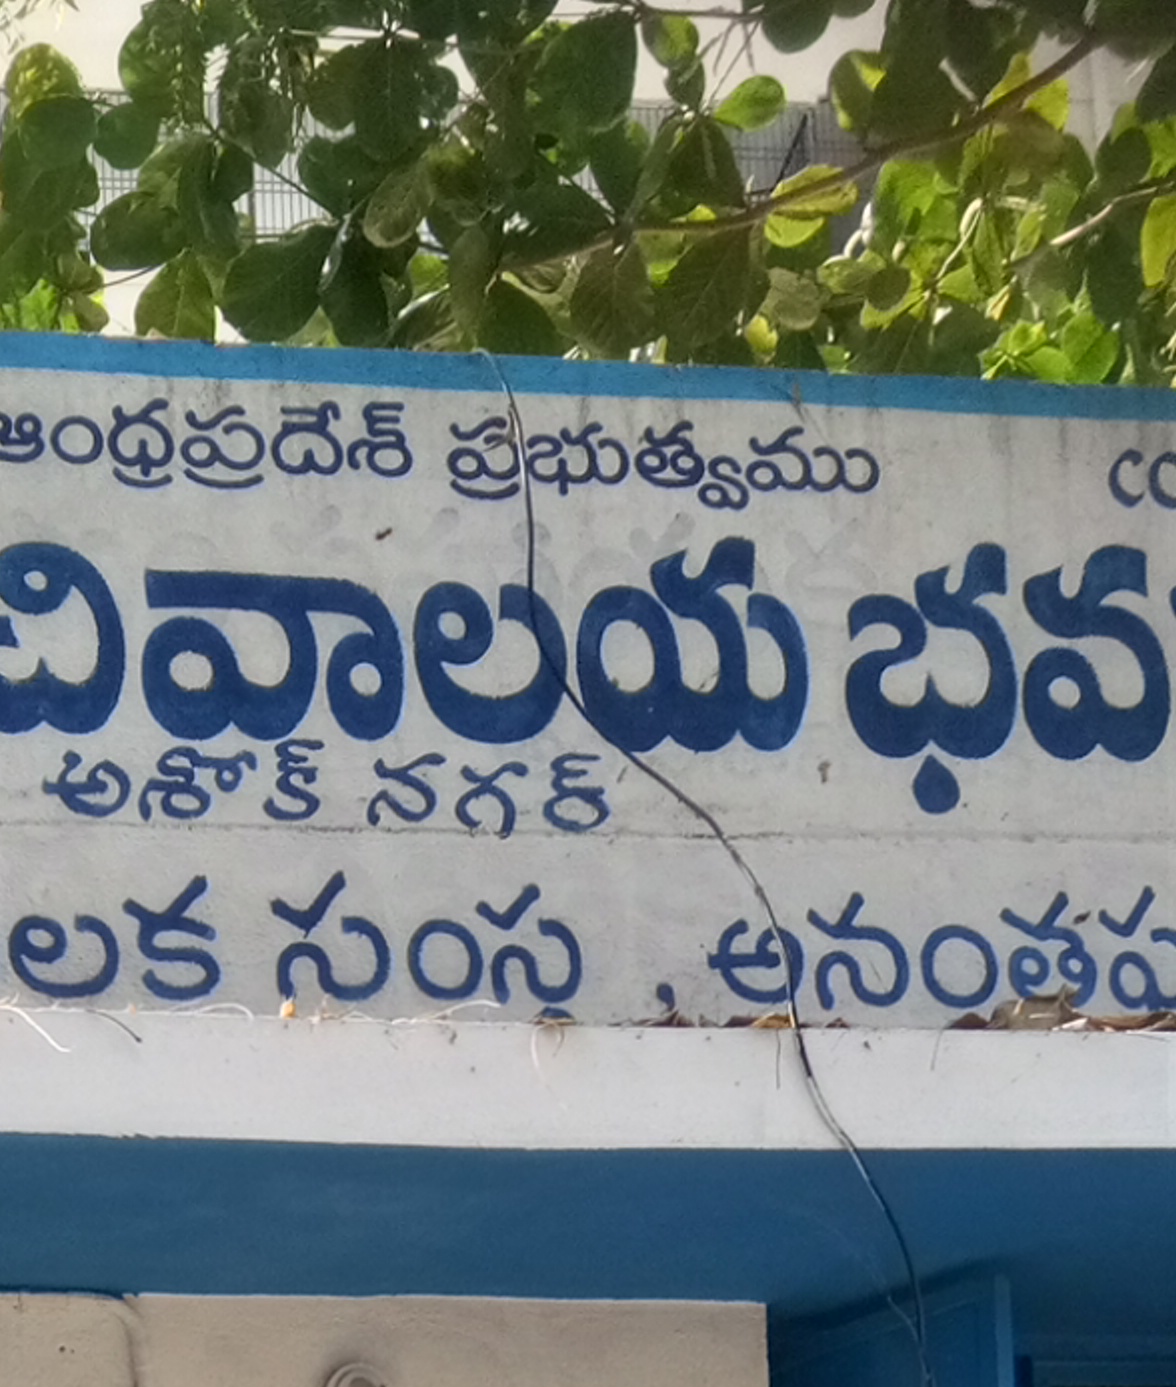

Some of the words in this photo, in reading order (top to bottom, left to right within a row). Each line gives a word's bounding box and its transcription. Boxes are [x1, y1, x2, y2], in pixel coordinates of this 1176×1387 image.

[444, 416, 881, 511] ప్రభుత్వము
[844, 542, 1176, 815] భవ
[41, 737, 325, 823] అశోక్
[366, 752, 611, 839] నగర్
